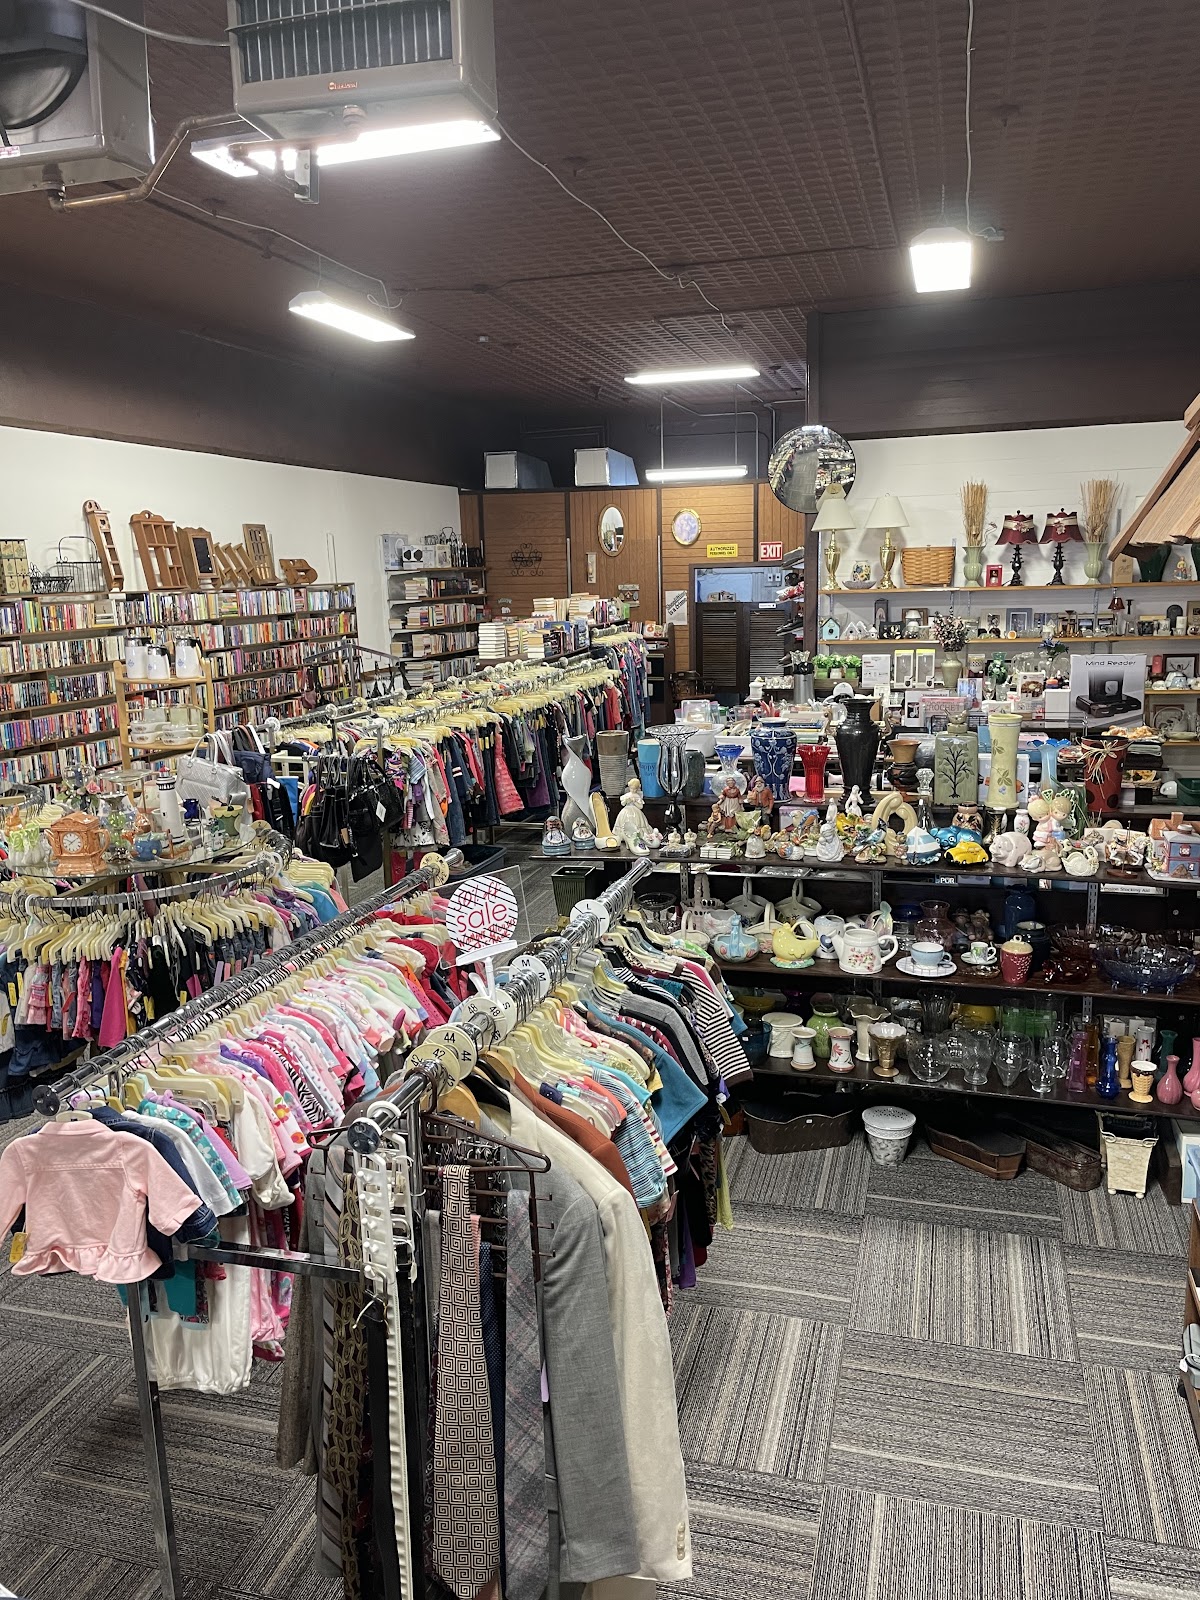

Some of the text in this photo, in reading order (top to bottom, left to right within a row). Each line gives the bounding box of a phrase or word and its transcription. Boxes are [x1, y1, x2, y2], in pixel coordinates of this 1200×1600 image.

[761, 544, 782, 558] EXIT
[924, 702, 961, 712] CROCHET
[585, 903, 592, 911] L
[456, 901, 508, 933] sale
[521, 959, 531, 967] M
[538, 972, 547, 981] M
[467, 1003, 479, 1015] 48
[489, 1006, 501, 1017] 48
[502, 1001, 511, 1010] S
[443, 1032, 456, 1044] 44
[410, 1053, 423, 1067] 42
[432, 1048, 446, 1061] 42
[461, 1049, 472, 1062] 44
